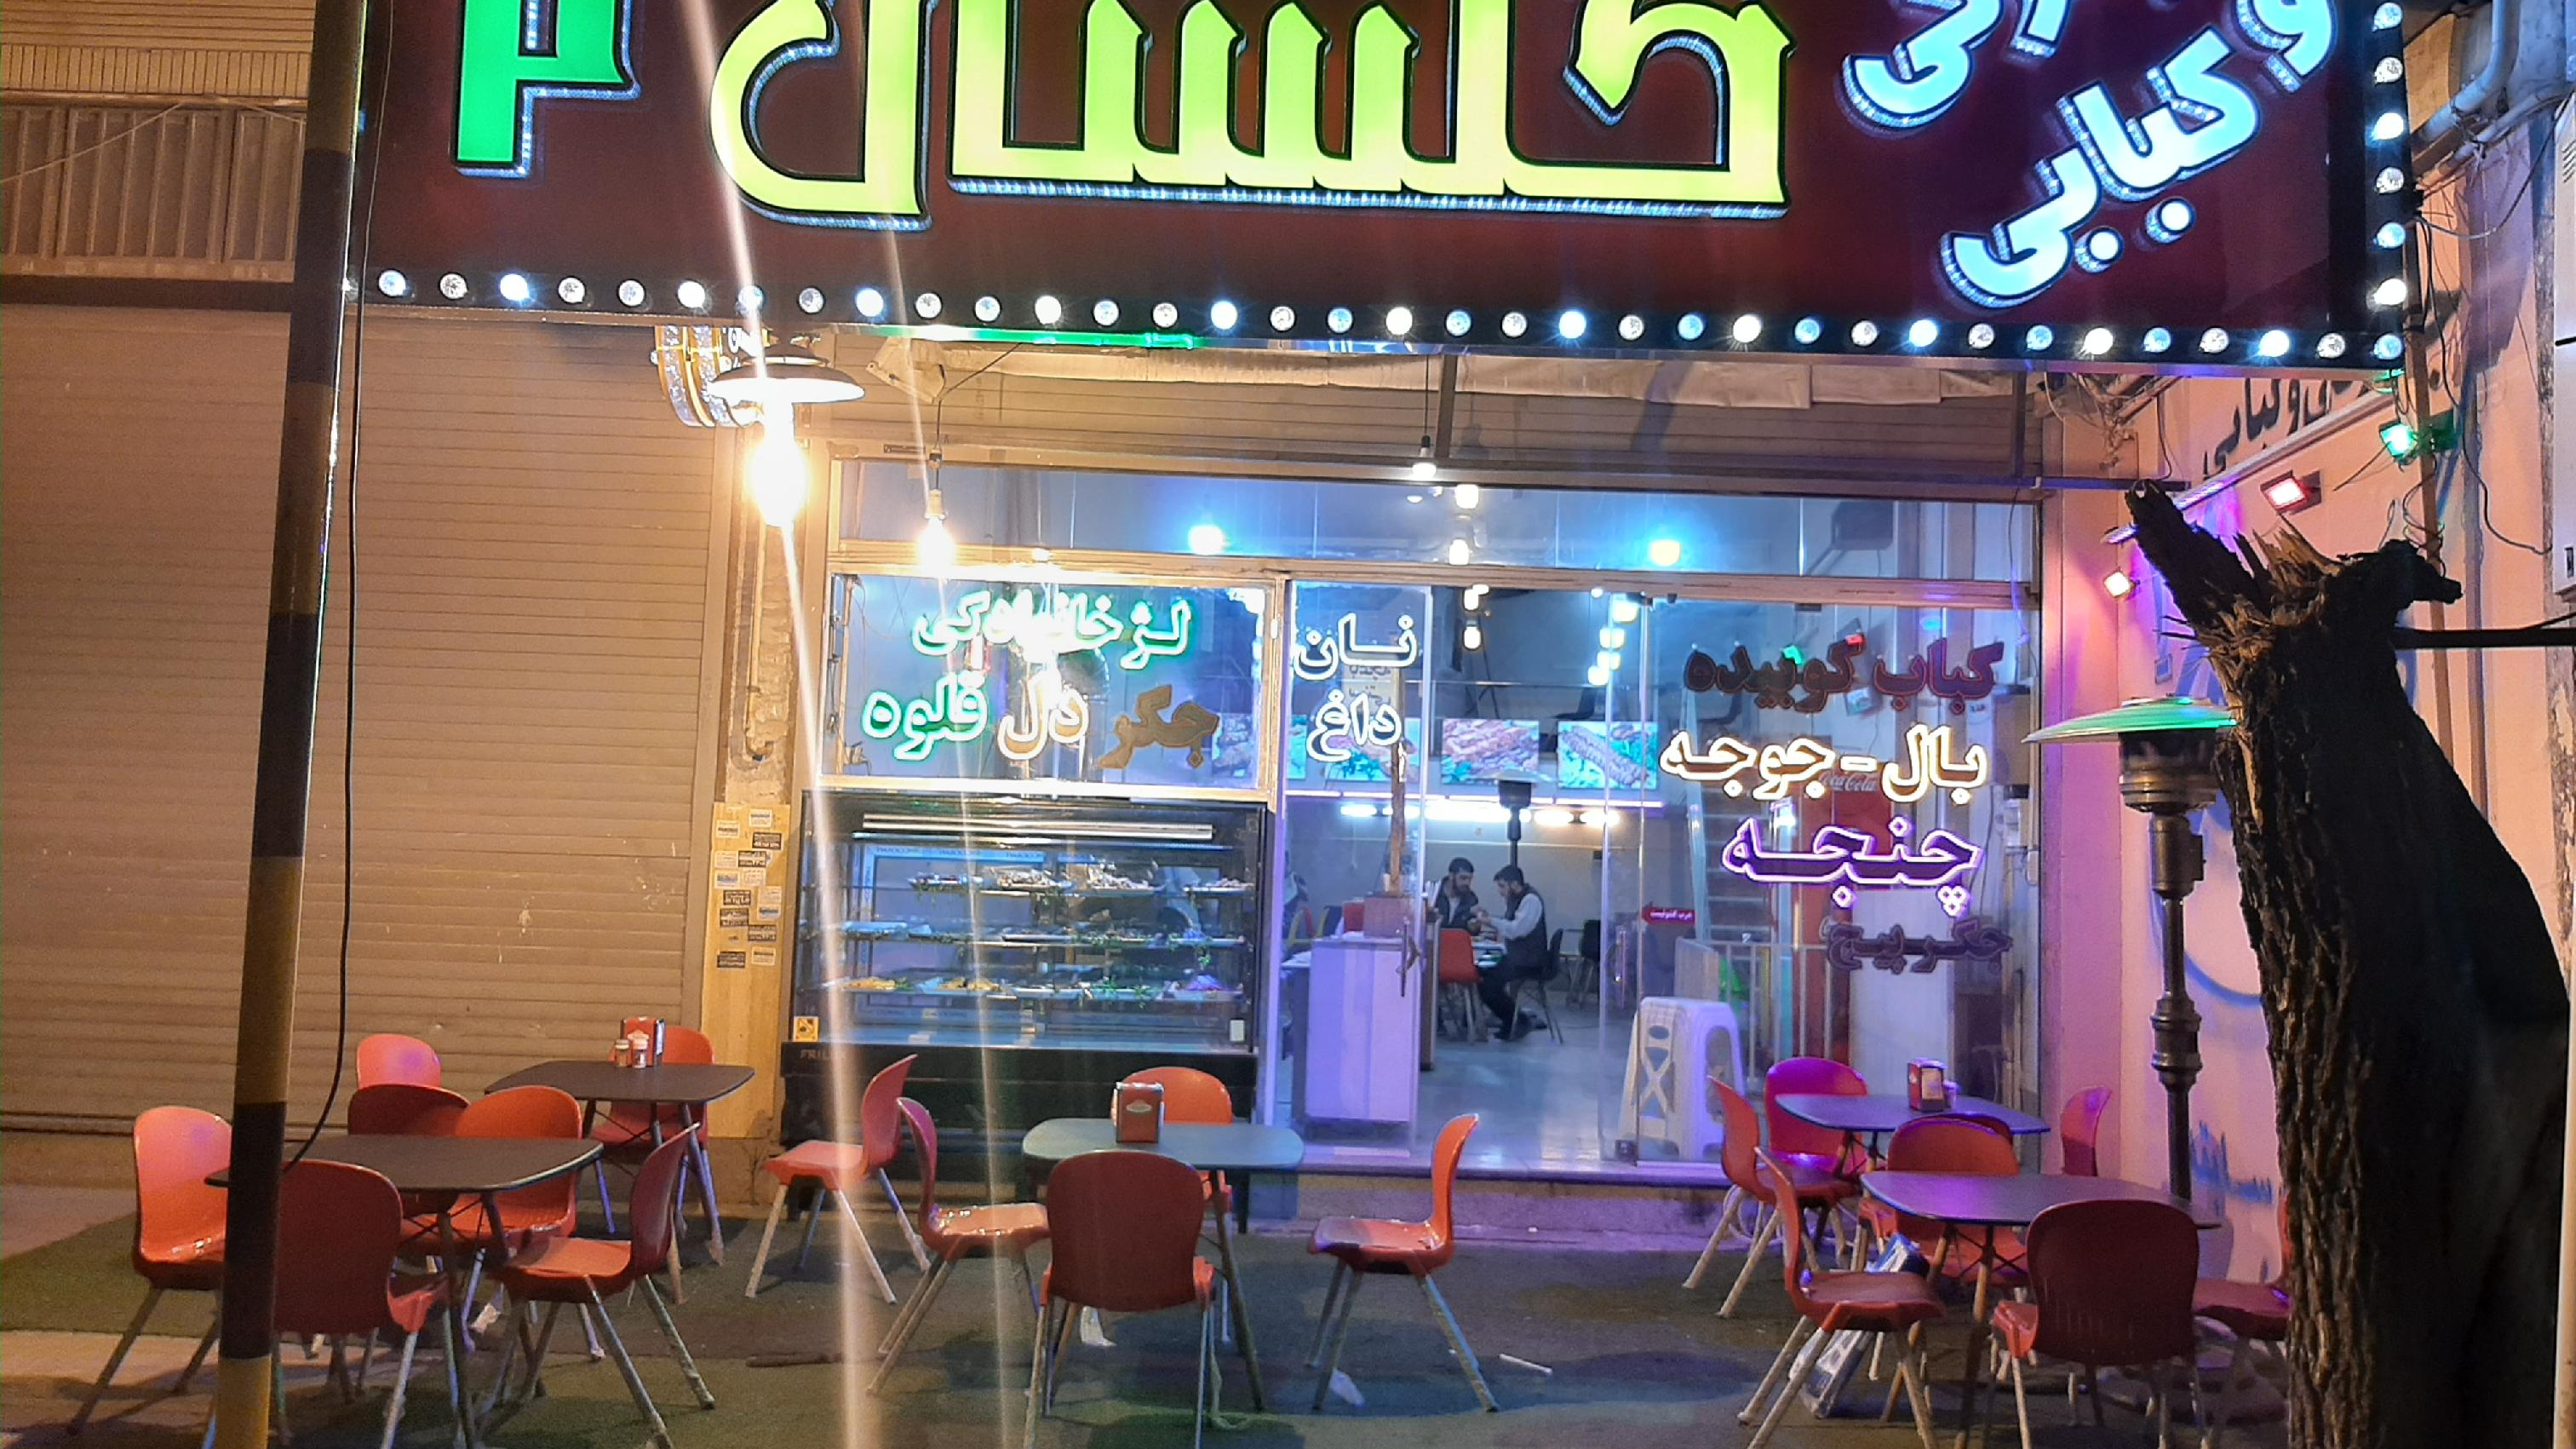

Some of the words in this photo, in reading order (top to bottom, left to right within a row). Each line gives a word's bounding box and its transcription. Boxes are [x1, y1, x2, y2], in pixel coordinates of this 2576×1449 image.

[1940, 24, 2262, 308] کبابی
[1293, 612, 1417, 681] نان
[1684, 634, 1867, 713] کوبیده
[1874, 638, 2005, 715] کباب
[862, 671, 989, 761] قلوه
[1306, 690, 1403, 762] داغ
[1720, 815, 1983, 918] چنجه
